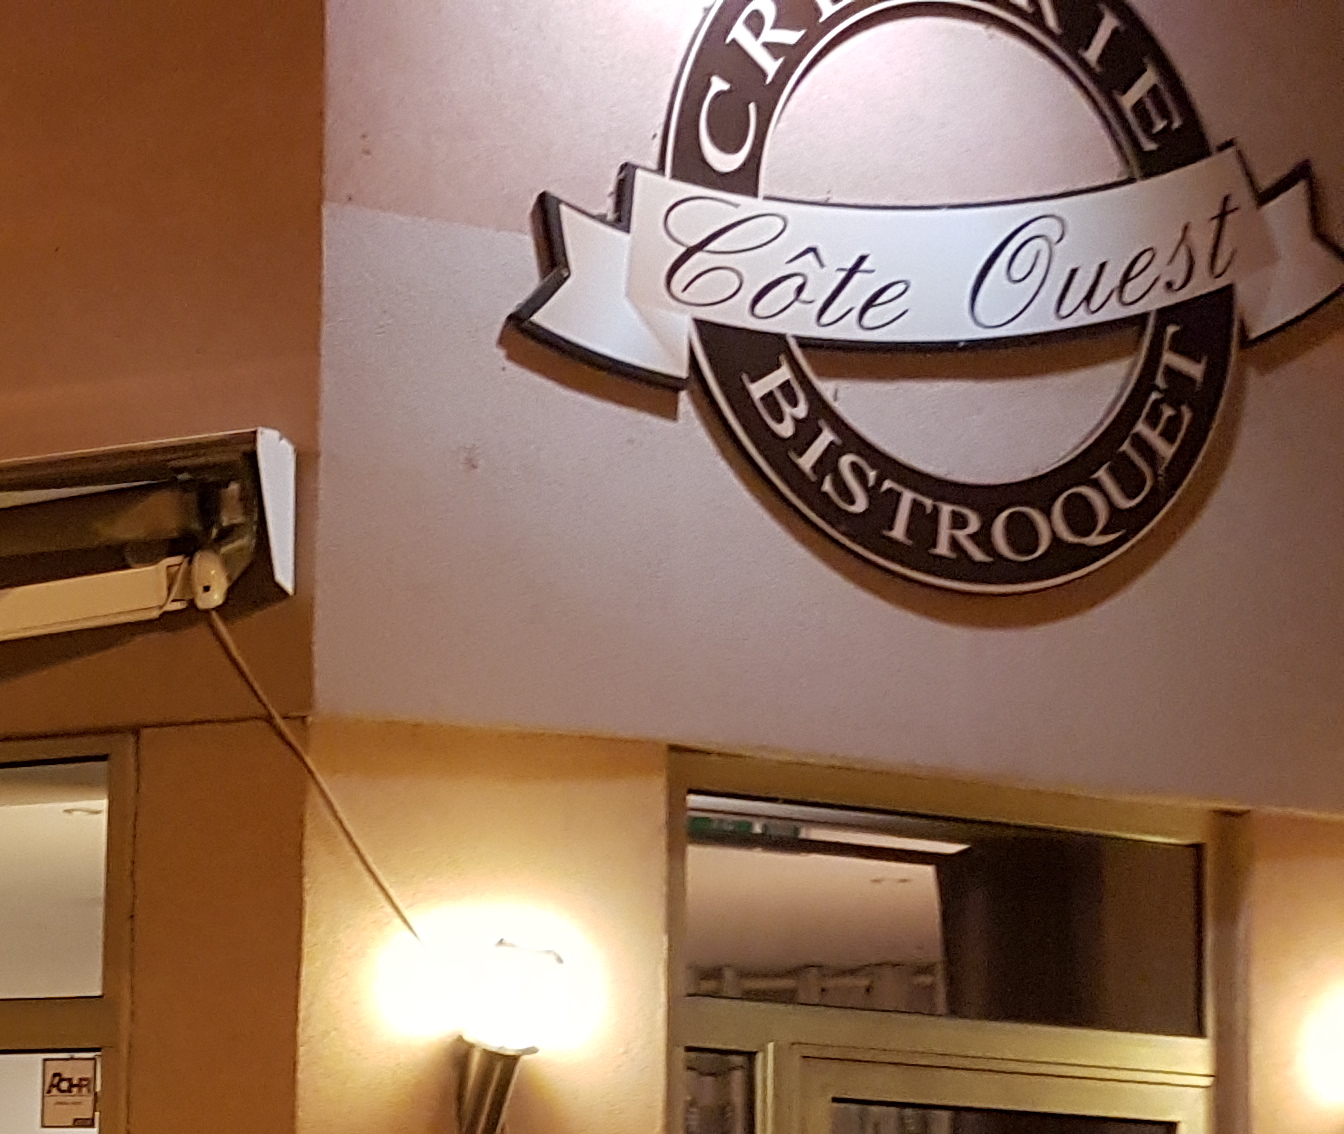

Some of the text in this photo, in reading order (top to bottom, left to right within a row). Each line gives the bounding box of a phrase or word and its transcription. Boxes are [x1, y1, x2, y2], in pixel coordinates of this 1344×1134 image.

[699, 0, 1182, 173] CRIE
[664, 194, 1244, 329] Côte Ouest
[742, 324, 1209, 562] BISTROQUET
